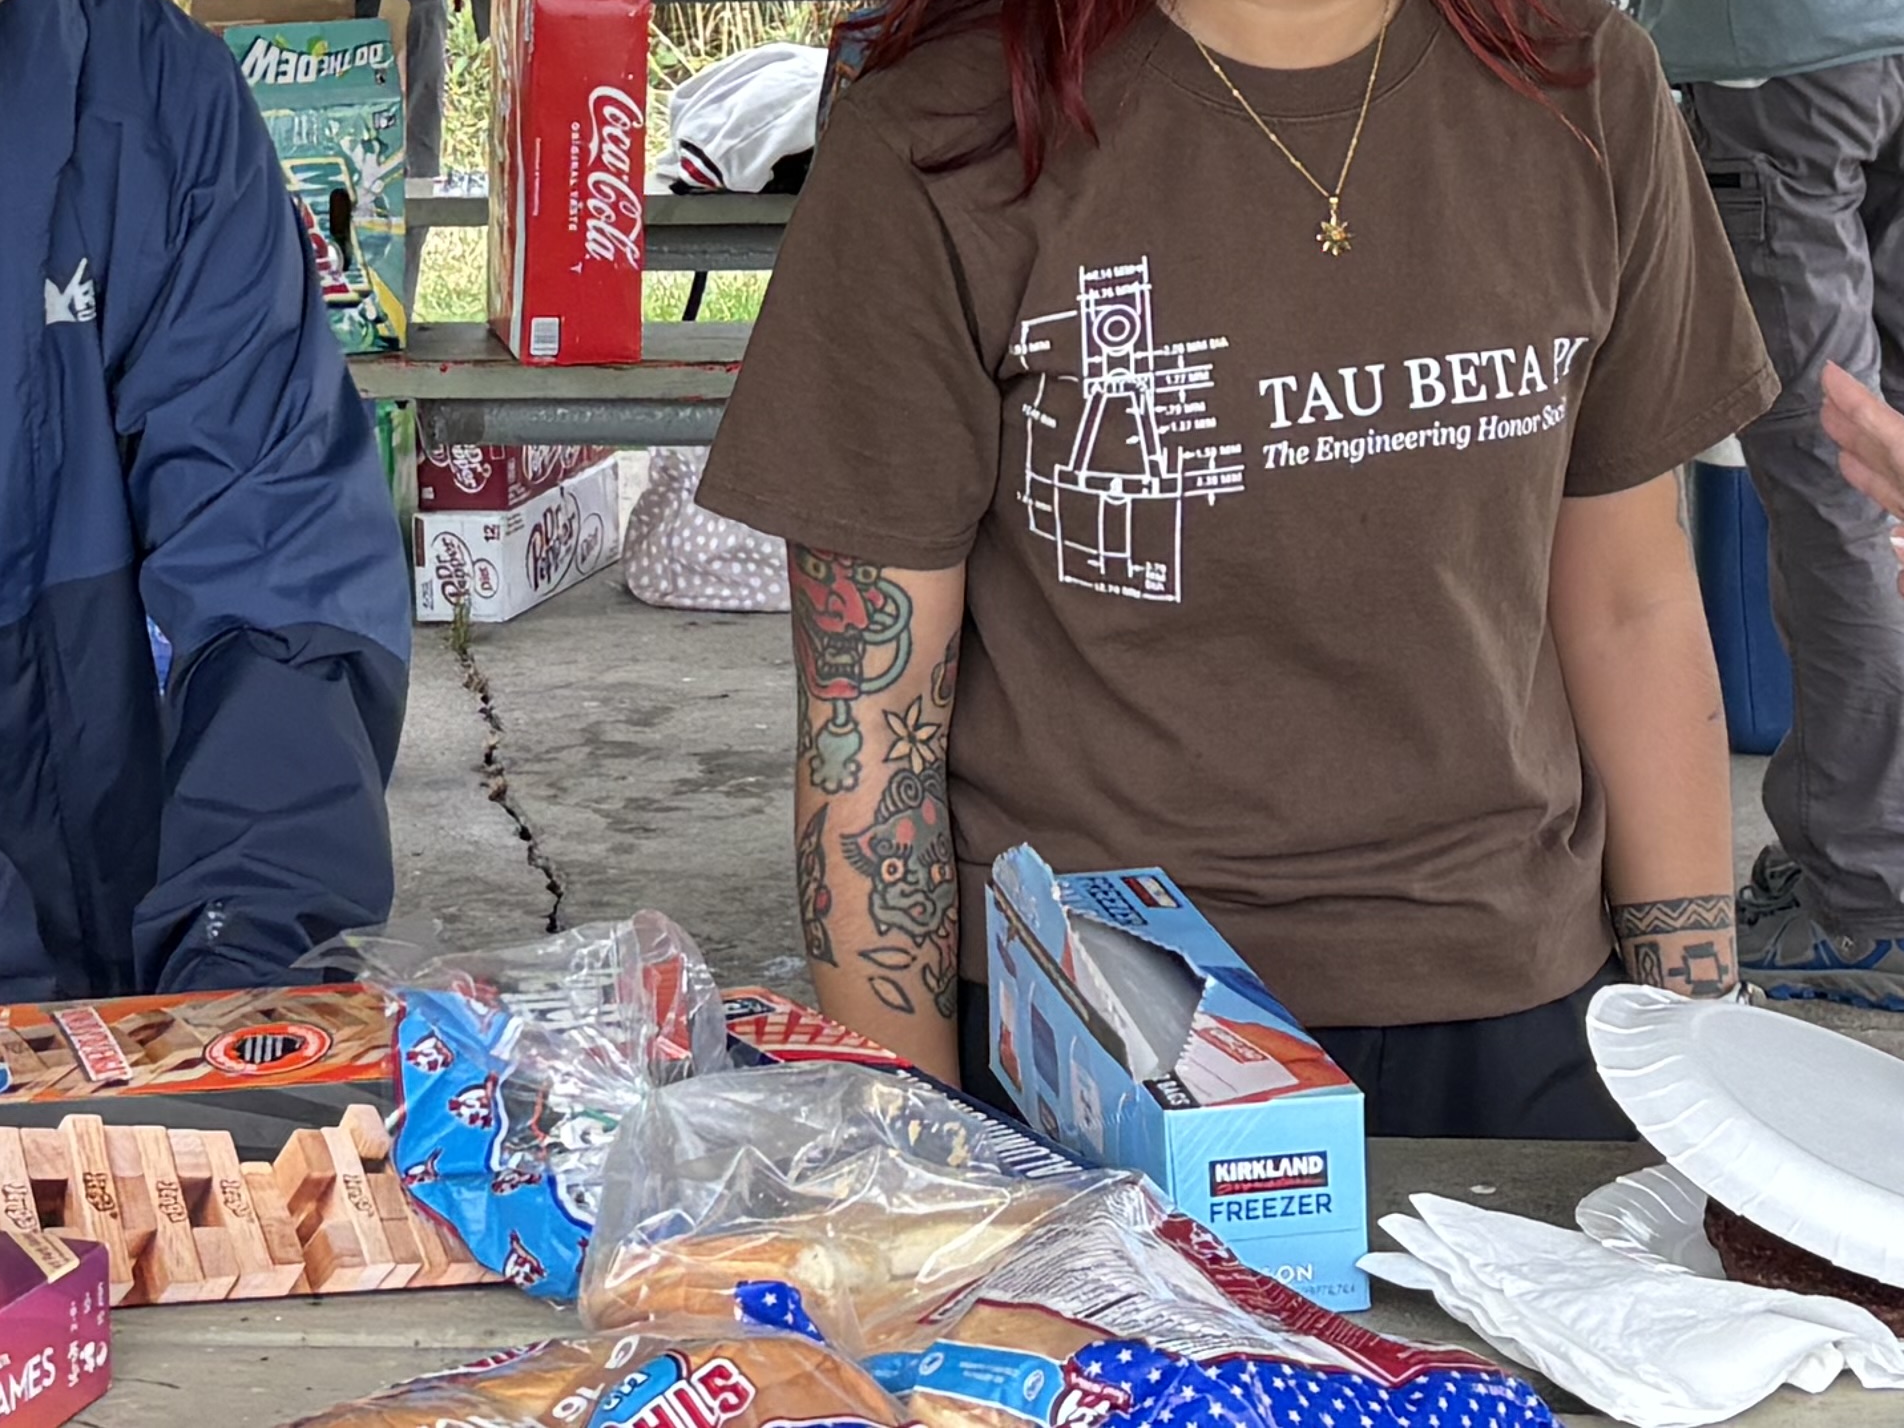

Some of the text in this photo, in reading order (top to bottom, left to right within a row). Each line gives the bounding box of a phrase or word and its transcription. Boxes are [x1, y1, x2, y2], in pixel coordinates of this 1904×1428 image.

[240, 36, 384, 86] DO THE DEW
[1258, 363, 1385, 429] TAU
[1403, 344, 1548, 409] BETA
[1262, 440, 1310, 469] The
[1314, 420, 1471, 463] Engineering
[1477, 414, 1542, 442] Honor
[483, 524, 498, 543] 12
[1214, 1154, 1325, 1184] KIRKLAND
[1209, 1192, 1333, 1224] FREEZER
